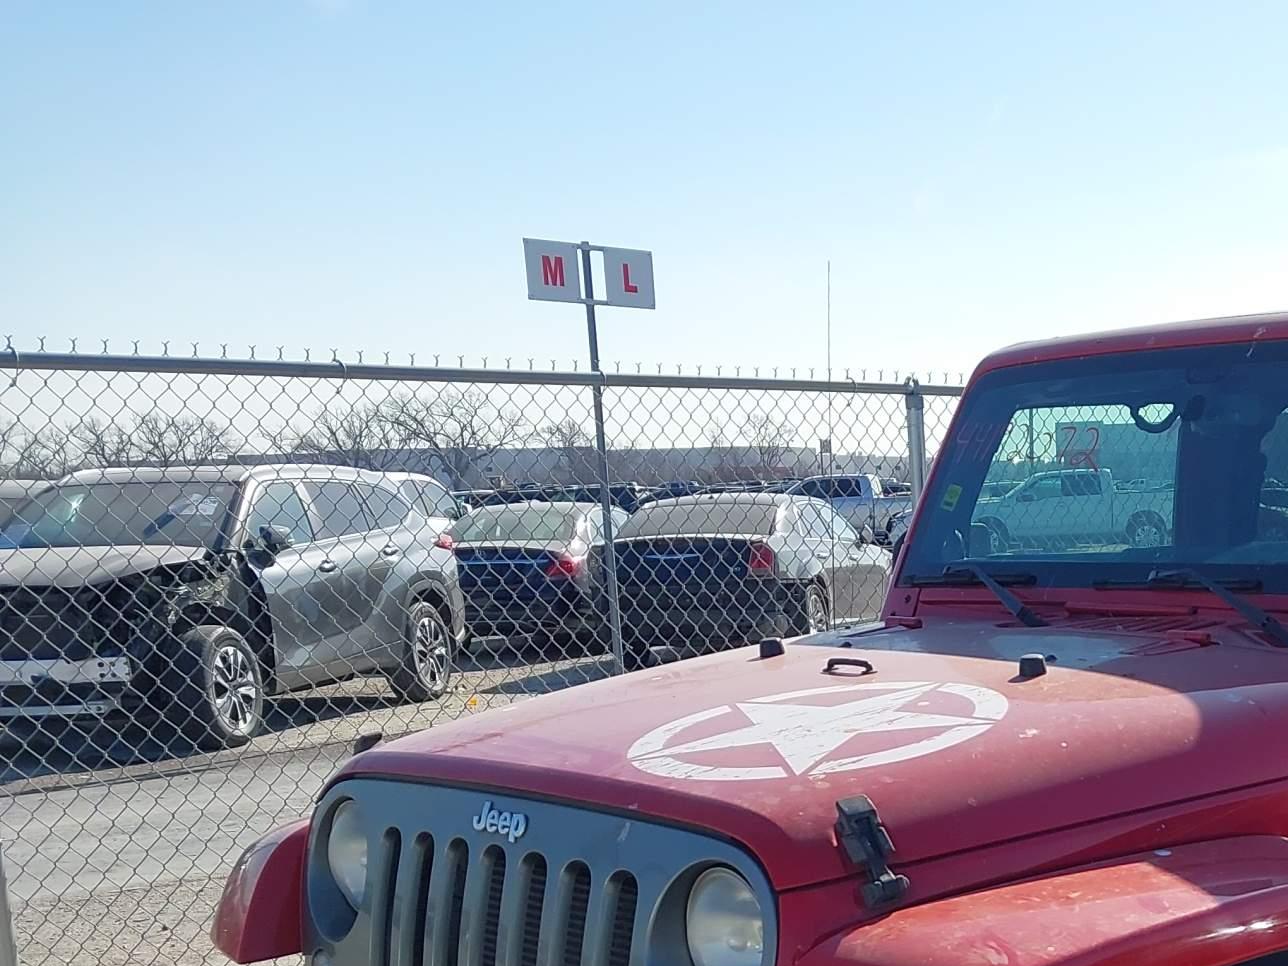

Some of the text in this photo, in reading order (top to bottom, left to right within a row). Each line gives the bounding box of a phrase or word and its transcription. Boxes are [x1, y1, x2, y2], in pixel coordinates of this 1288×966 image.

[541, 255, 565, 287] M
[622, 263, 639, 293] L
[473, 800, 527, 843] Jeep
